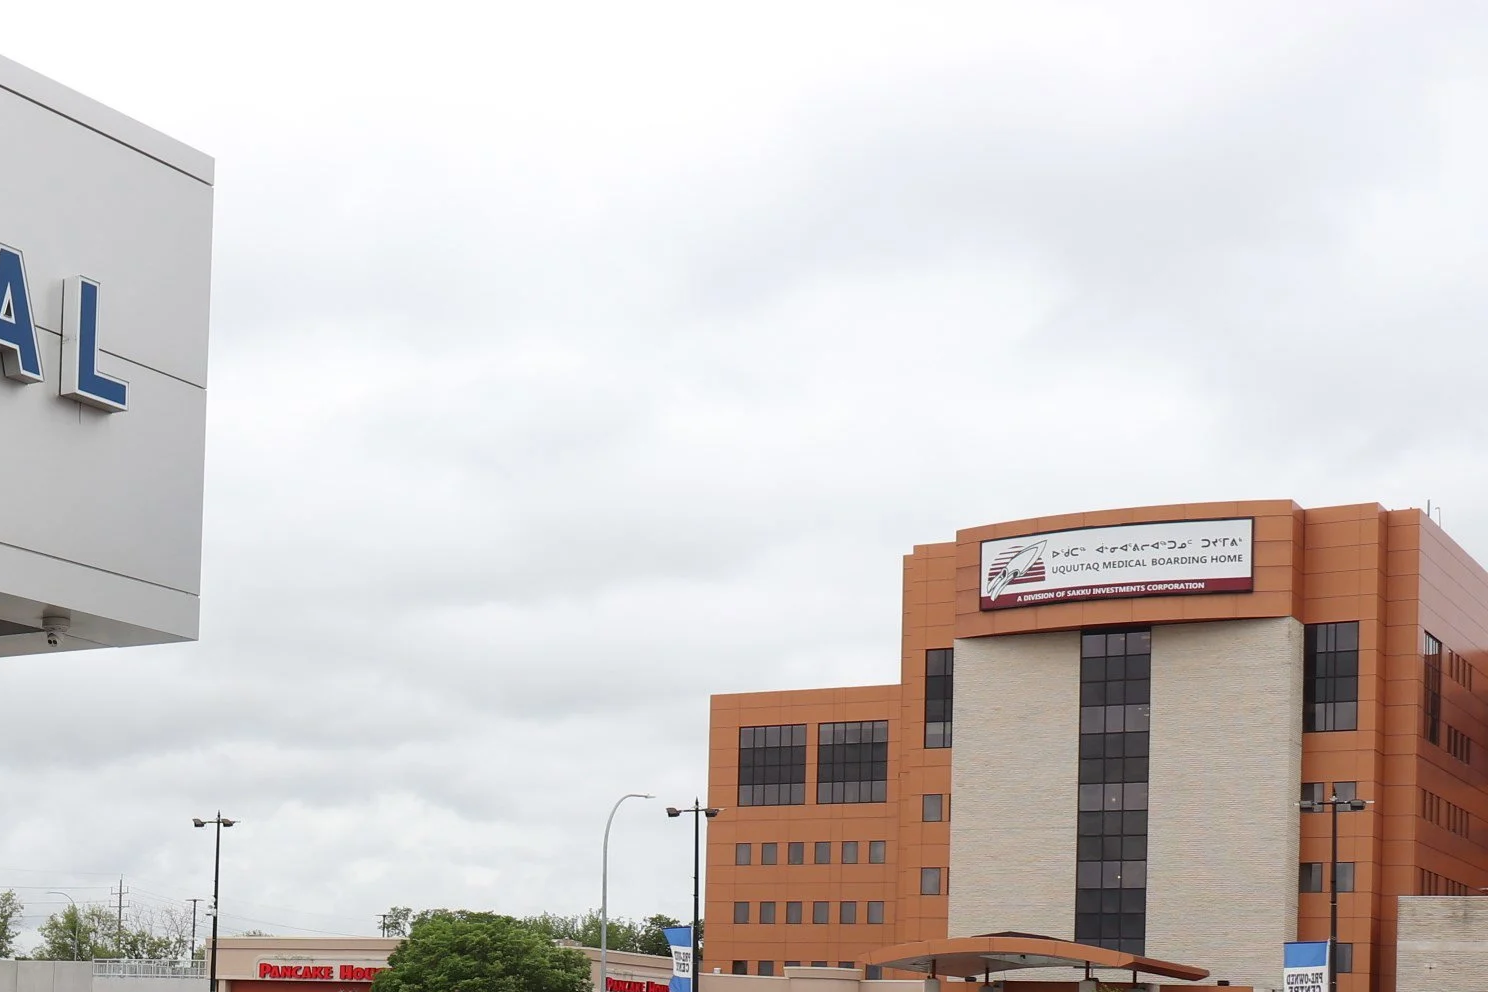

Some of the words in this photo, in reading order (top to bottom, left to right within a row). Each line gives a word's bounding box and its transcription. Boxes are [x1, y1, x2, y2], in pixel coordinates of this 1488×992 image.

[1051, 562, 1100, 574] UQUUTAQ
[1102, 559, 1147, 569] MEDICAL
[1151, 555, 1207, 566] BOARDING
[1210, 554, 1243, 563] HOME
[1023, 592, 1055, 602] DIVISION
[1056, 590, 1066, 598] OF
[1066, 588, 1091, 597] SAKKU
[1092, 585, 1146, 595] INVESTMENTS
[1146, 582, 1205, 591] CORPORATION
[259, 963, 334, 979] PANCAKE
[339, 965, 394, 980] HOU
